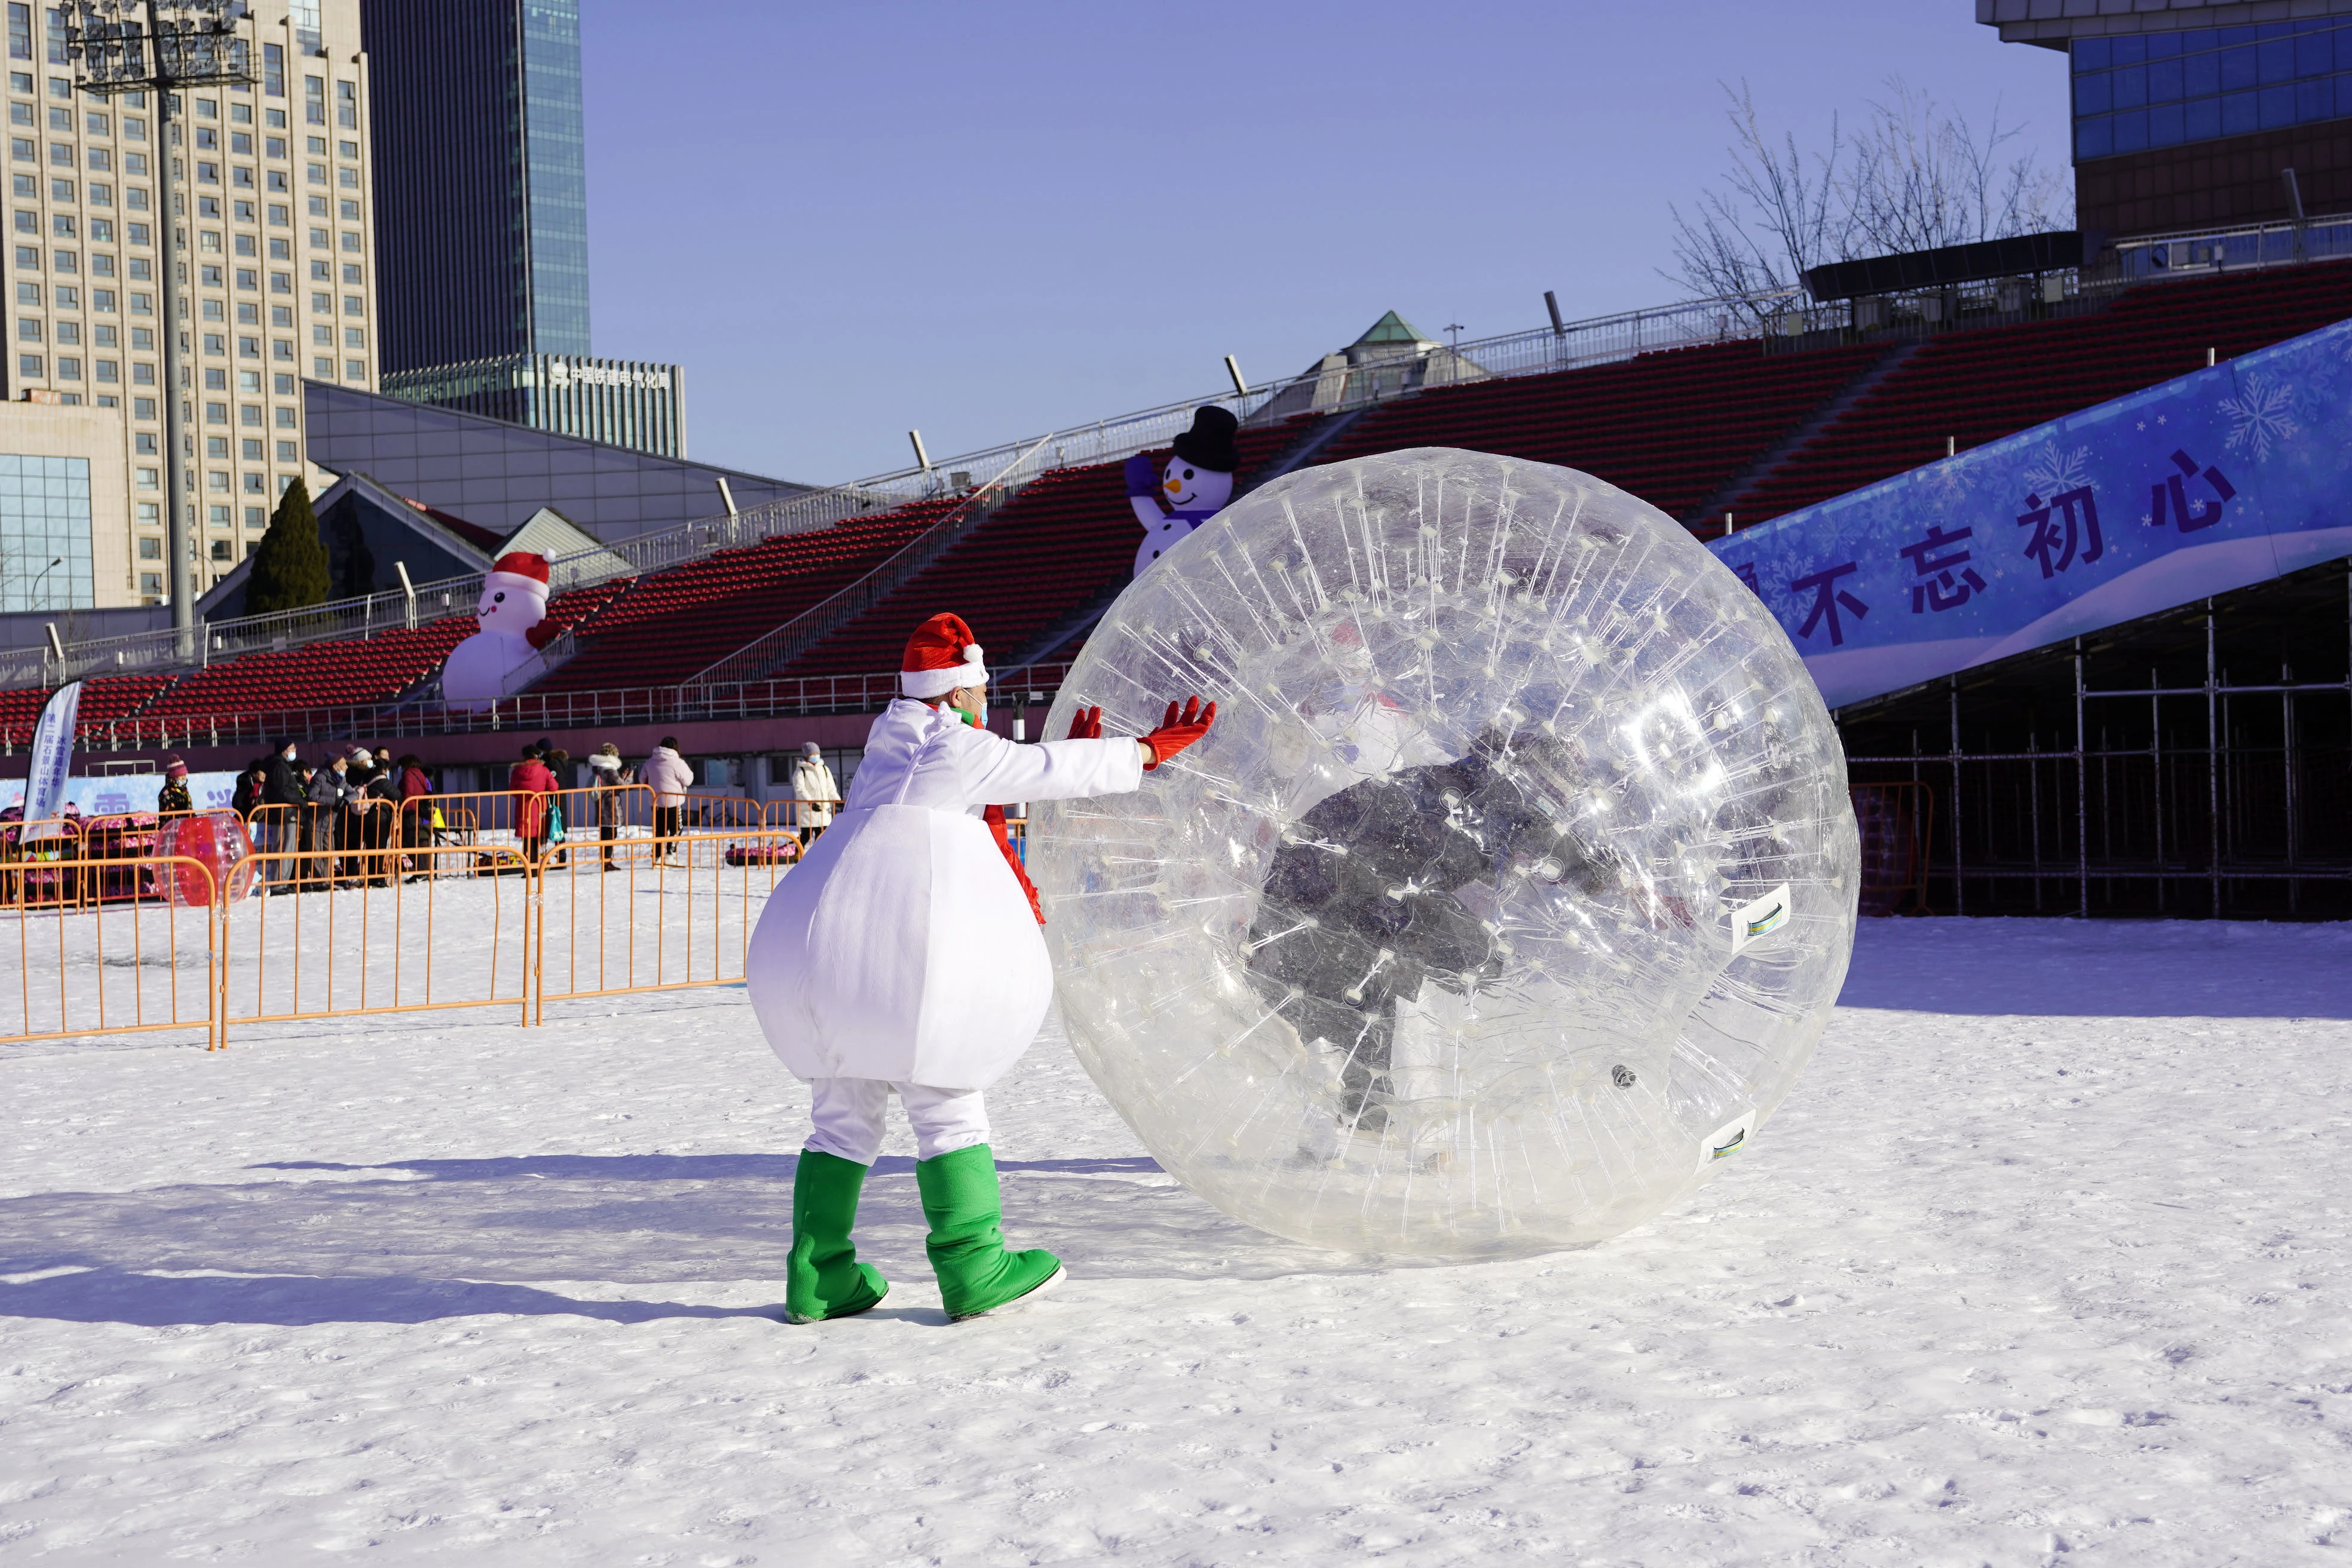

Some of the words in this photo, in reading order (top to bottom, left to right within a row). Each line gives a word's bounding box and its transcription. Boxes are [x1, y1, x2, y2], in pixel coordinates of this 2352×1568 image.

[571, 366, 670, 390] 中国铁建电气化局
[1791, 449, 2237, 647] 不忘初心
